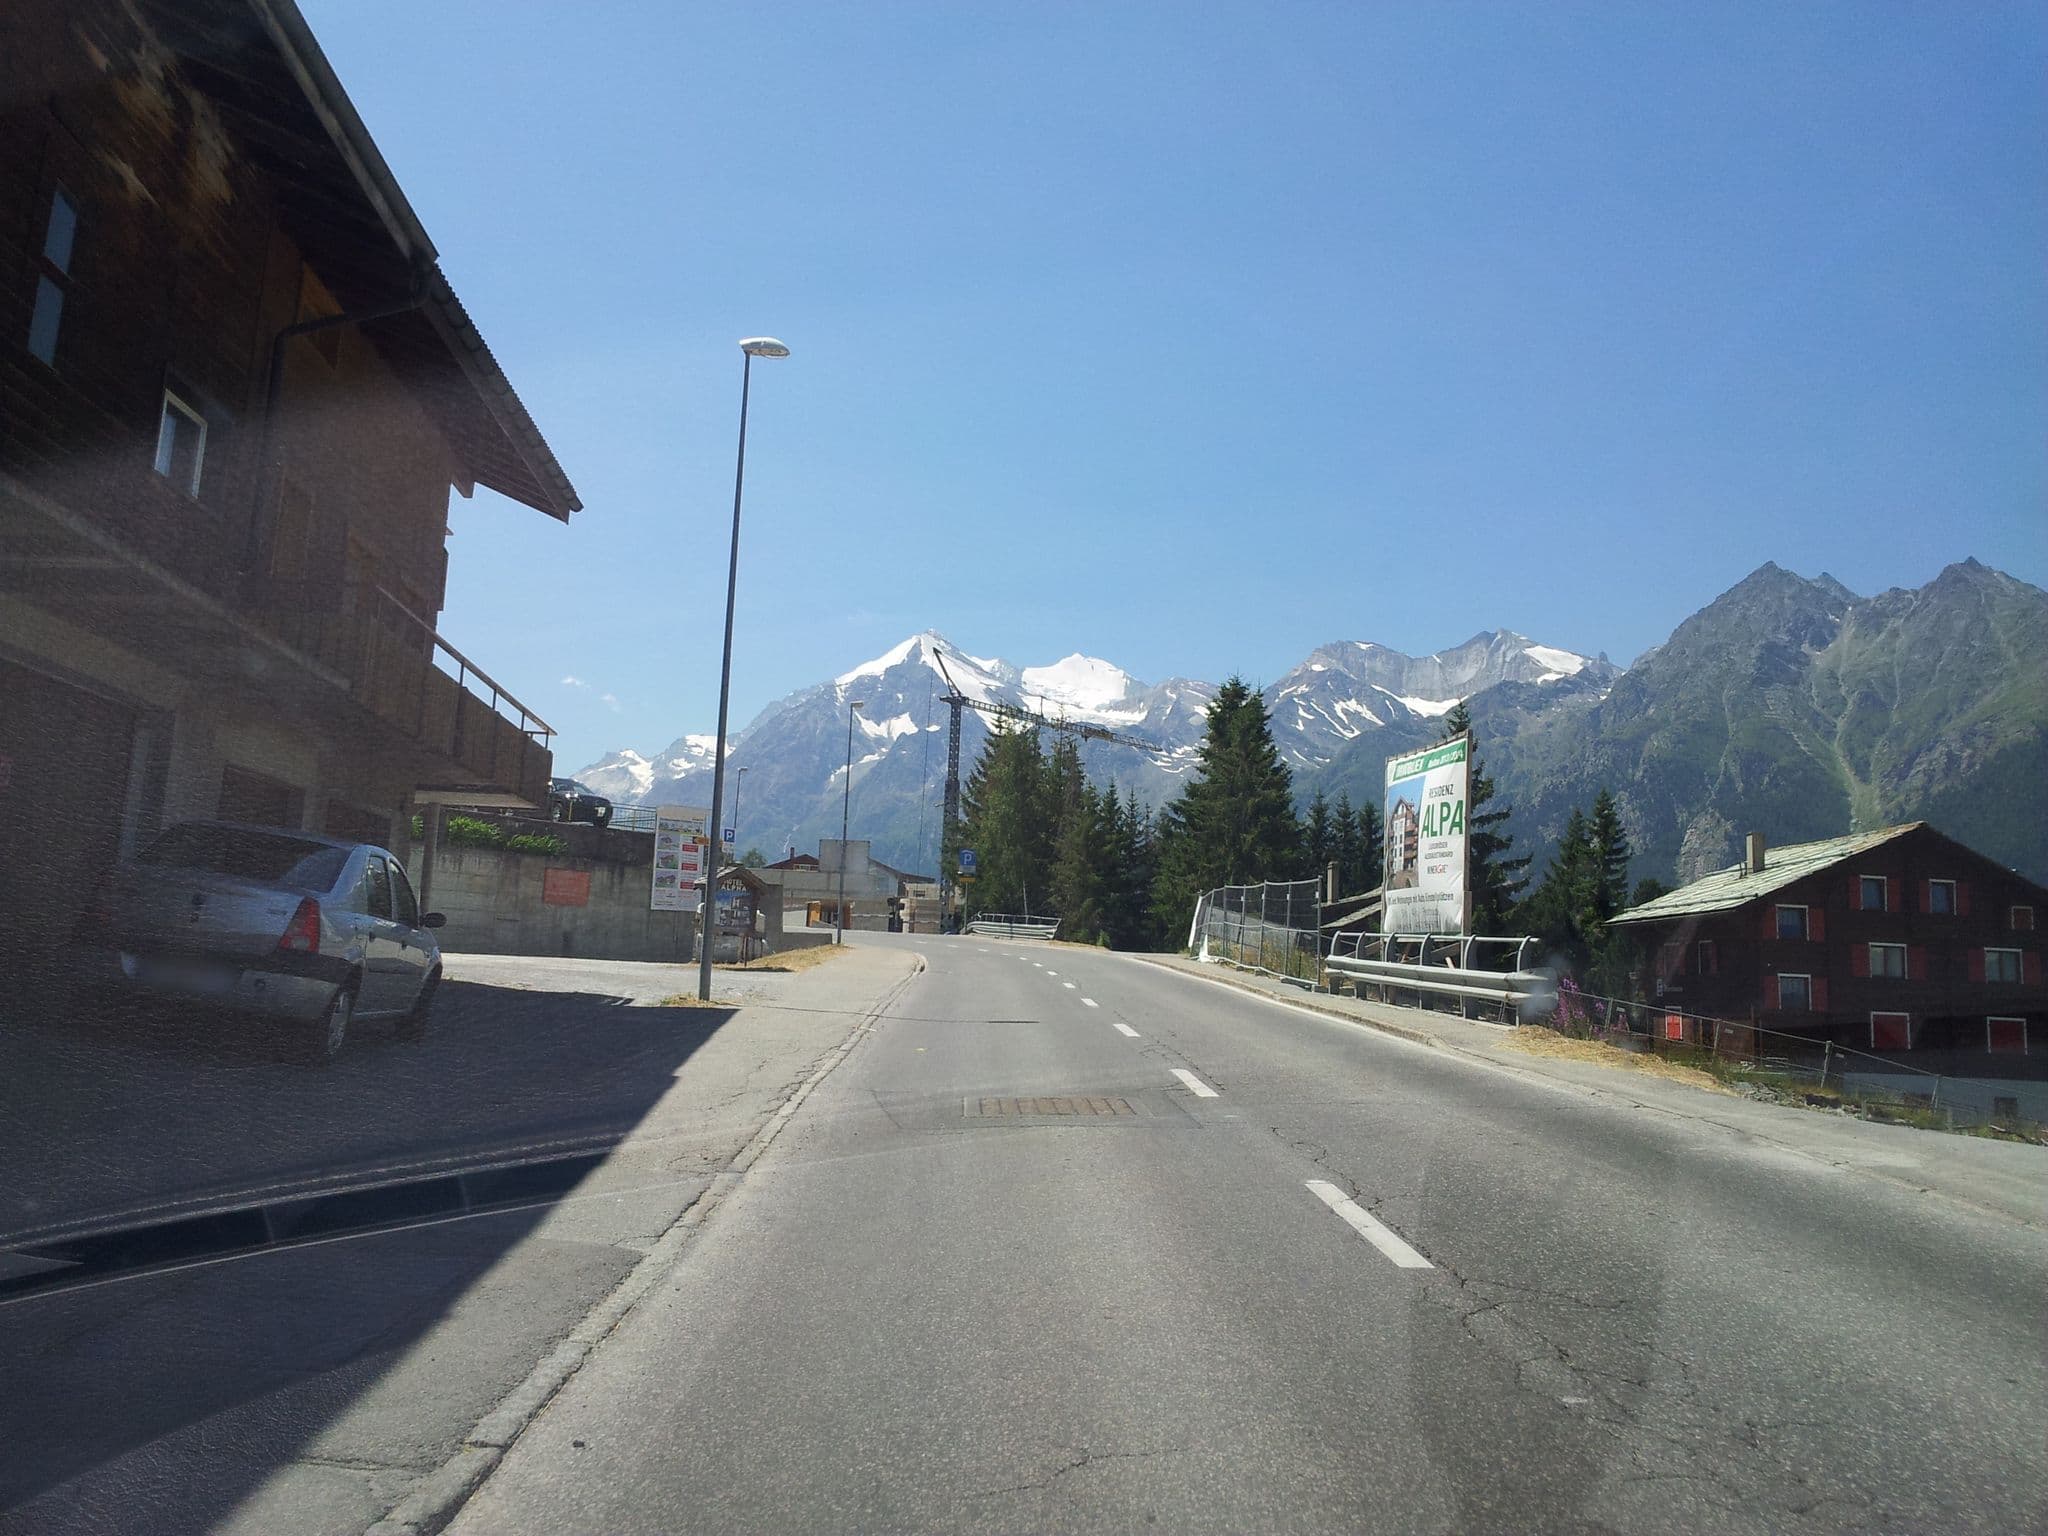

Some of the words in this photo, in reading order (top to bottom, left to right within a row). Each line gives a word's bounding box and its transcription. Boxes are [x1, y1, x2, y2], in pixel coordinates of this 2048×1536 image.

[1429, 784, 1454, 798] RESIDENZ
[1420, 800, 1463, 839] ALPA
[963, 853, 973, 865] P
